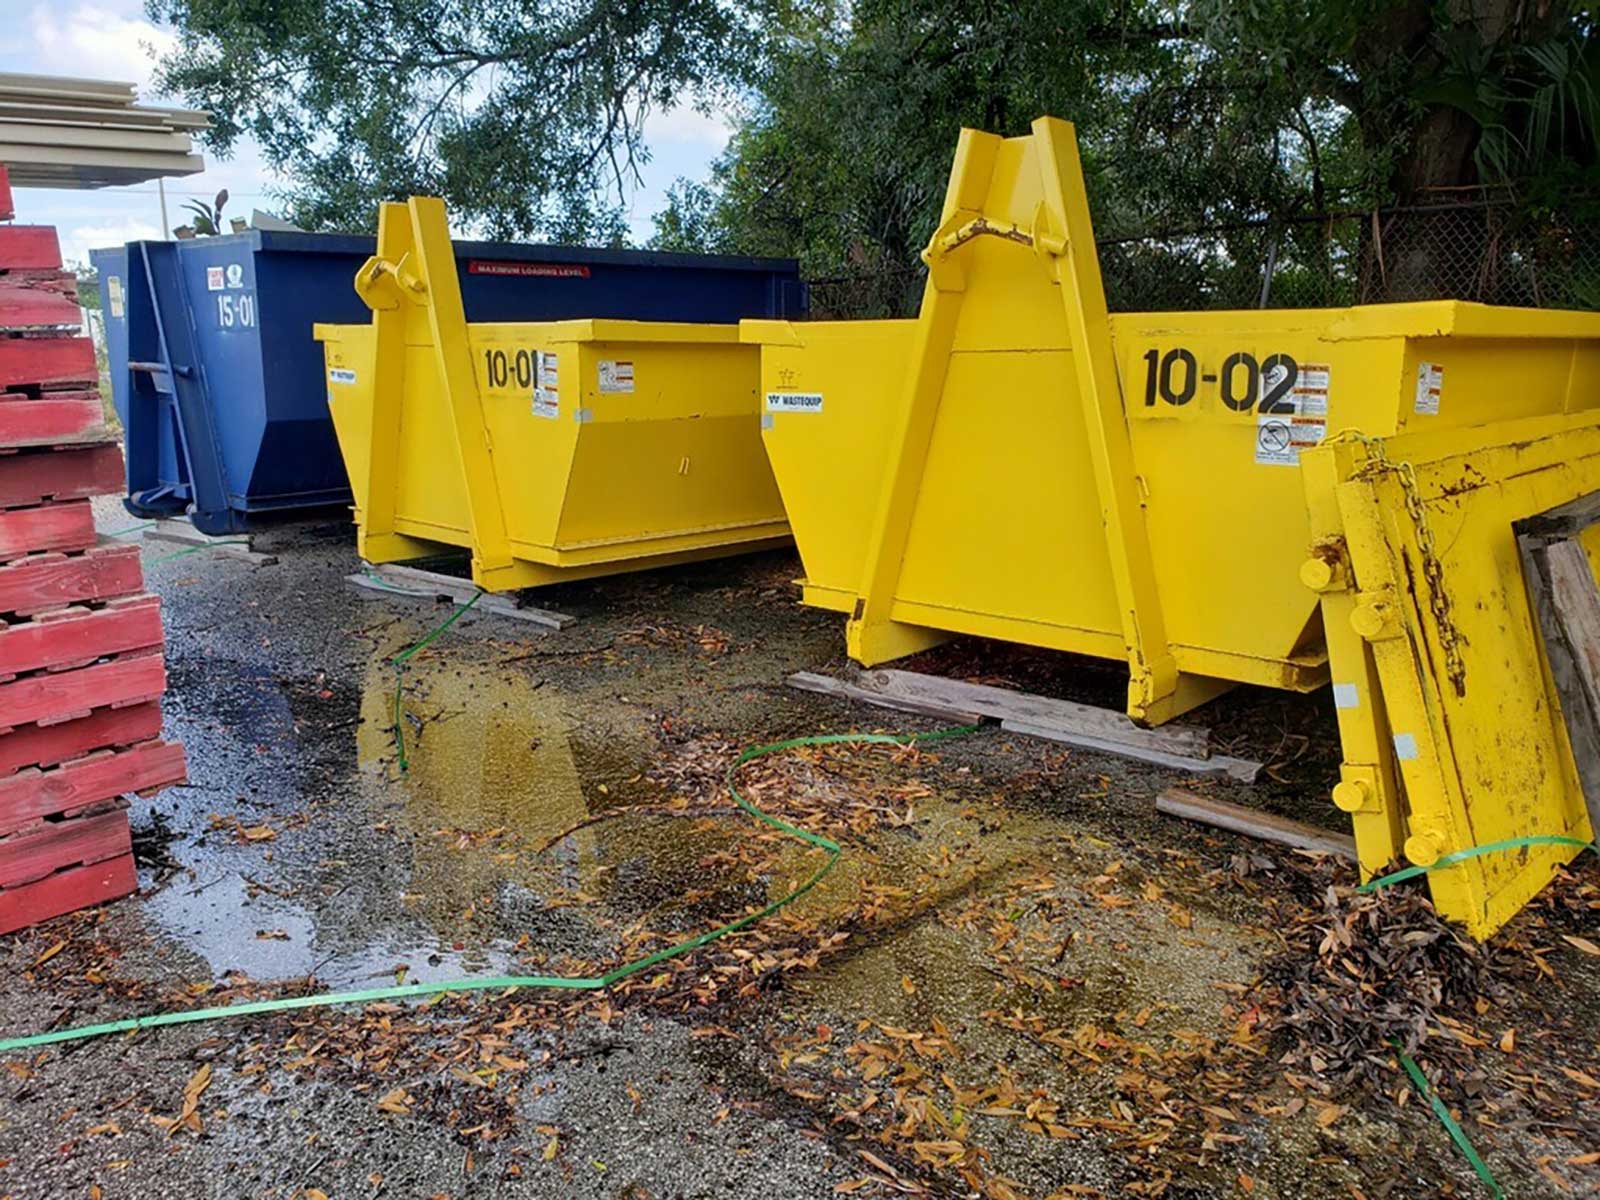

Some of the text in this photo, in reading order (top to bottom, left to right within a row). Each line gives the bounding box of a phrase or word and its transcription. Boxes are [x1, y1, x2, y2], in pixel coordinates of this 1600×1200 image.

[478, 266, 584, 276] MAXIMUM LOADING LEVEL
[218, 295, 254, 327] 15-01
[485, 349, 538, 389] 10-01
[1143, 348, 1298, 414] 10-02
[782, 395, 822, 407] WASTEQUIP
